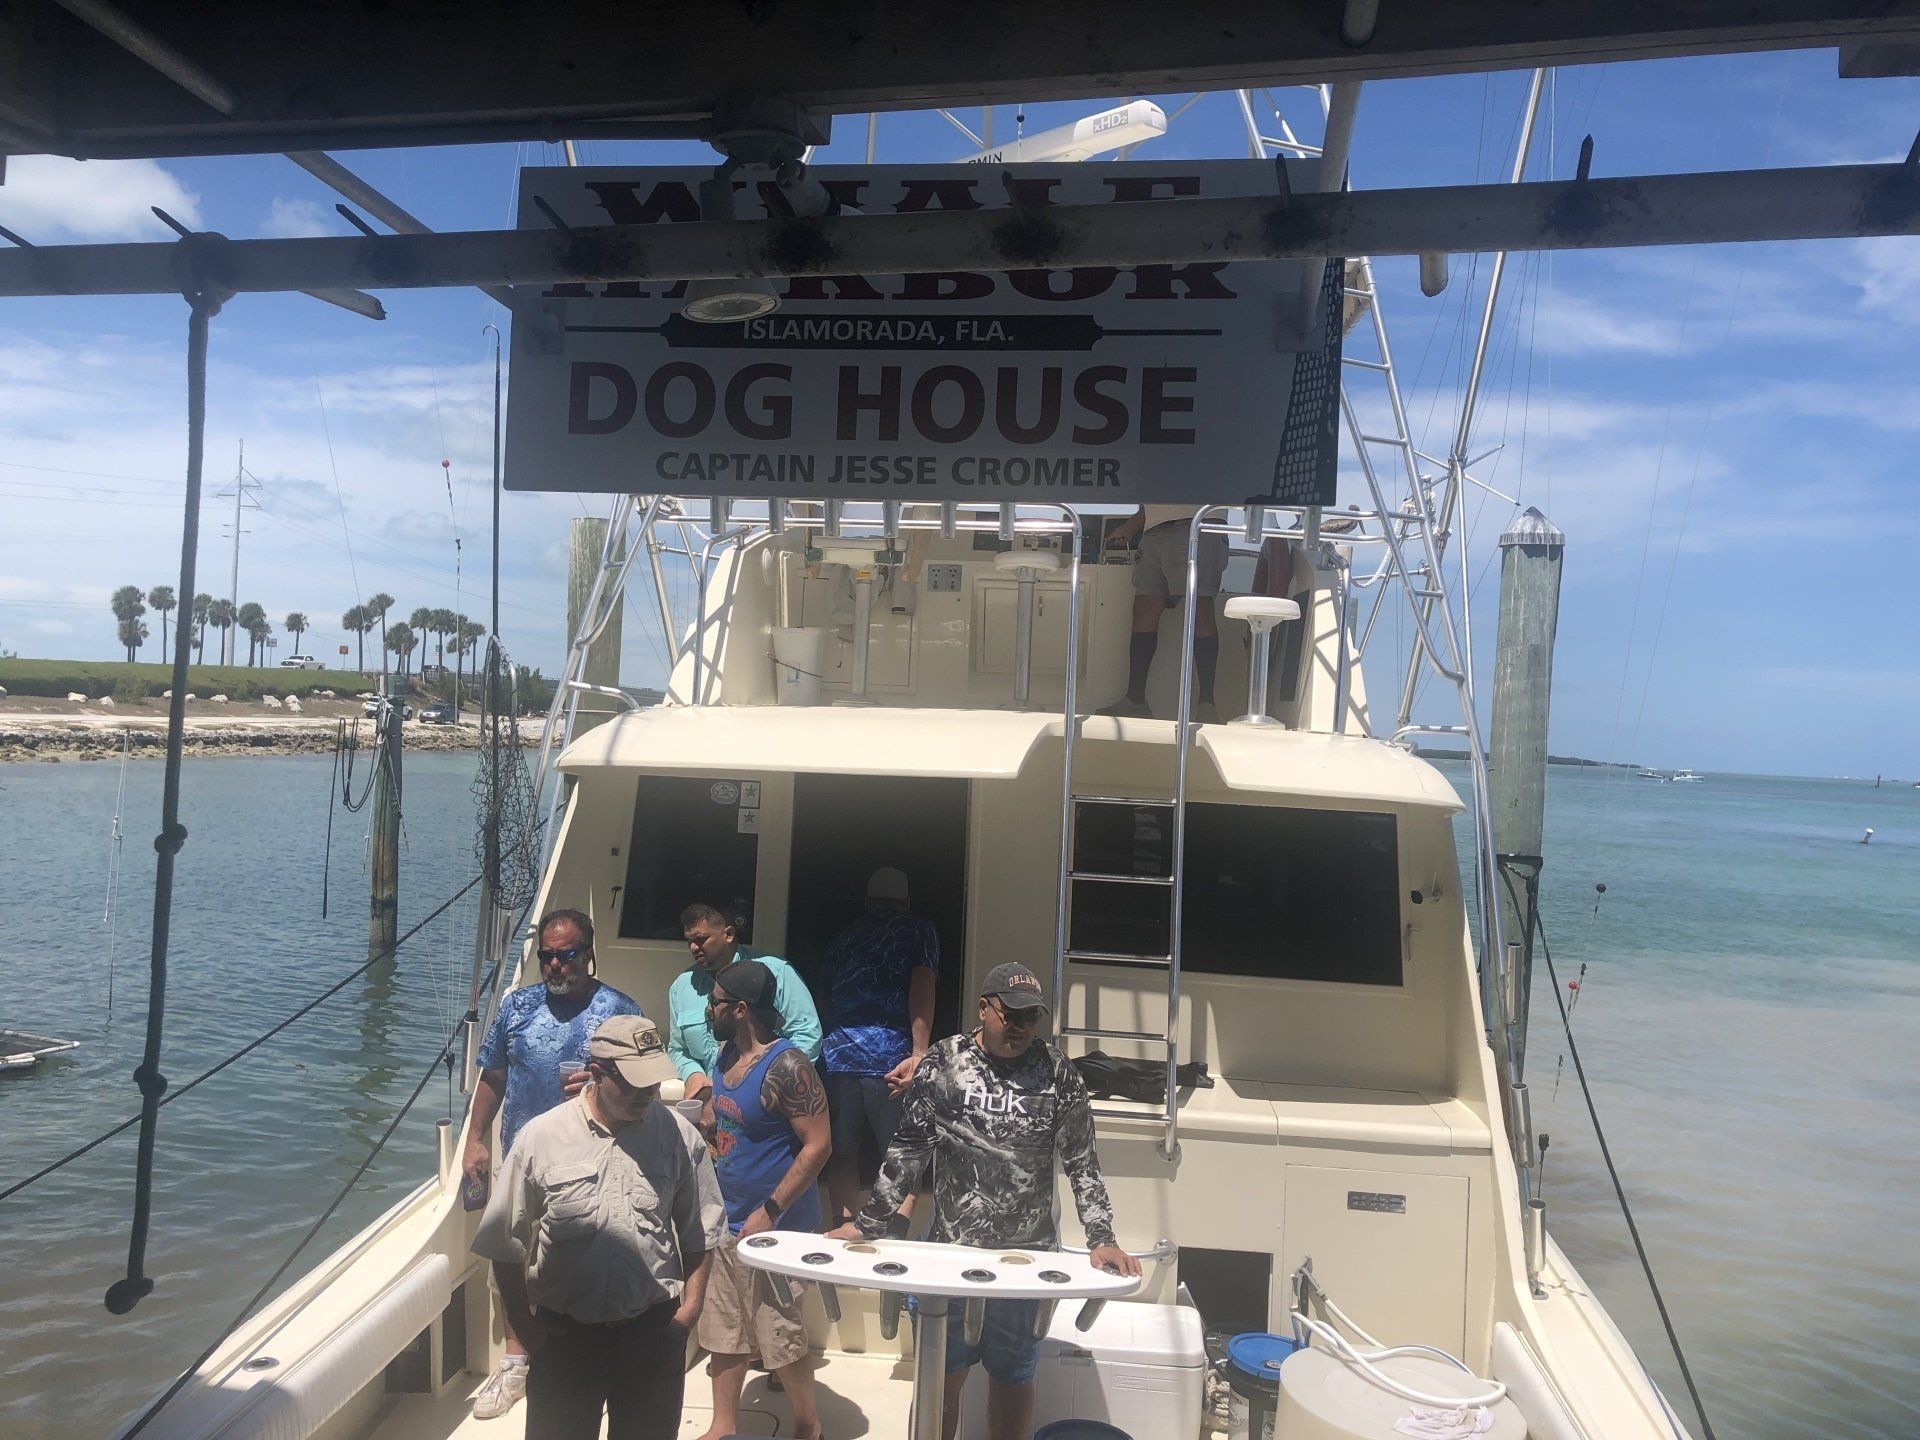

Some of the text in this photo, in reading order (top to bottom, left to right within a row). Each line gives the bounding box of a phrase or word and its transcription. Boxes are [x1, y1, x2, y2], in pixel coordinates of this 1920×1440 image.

[743, 319, 1015, 345] ISLAMORADA, FLA.
[567, 360, 1198, 446] DOG HOUSE
[655, 451, 1121, 488] CAPTAIN JESSE CROMER
[1009, 974, 1042, 995] ORLAN
